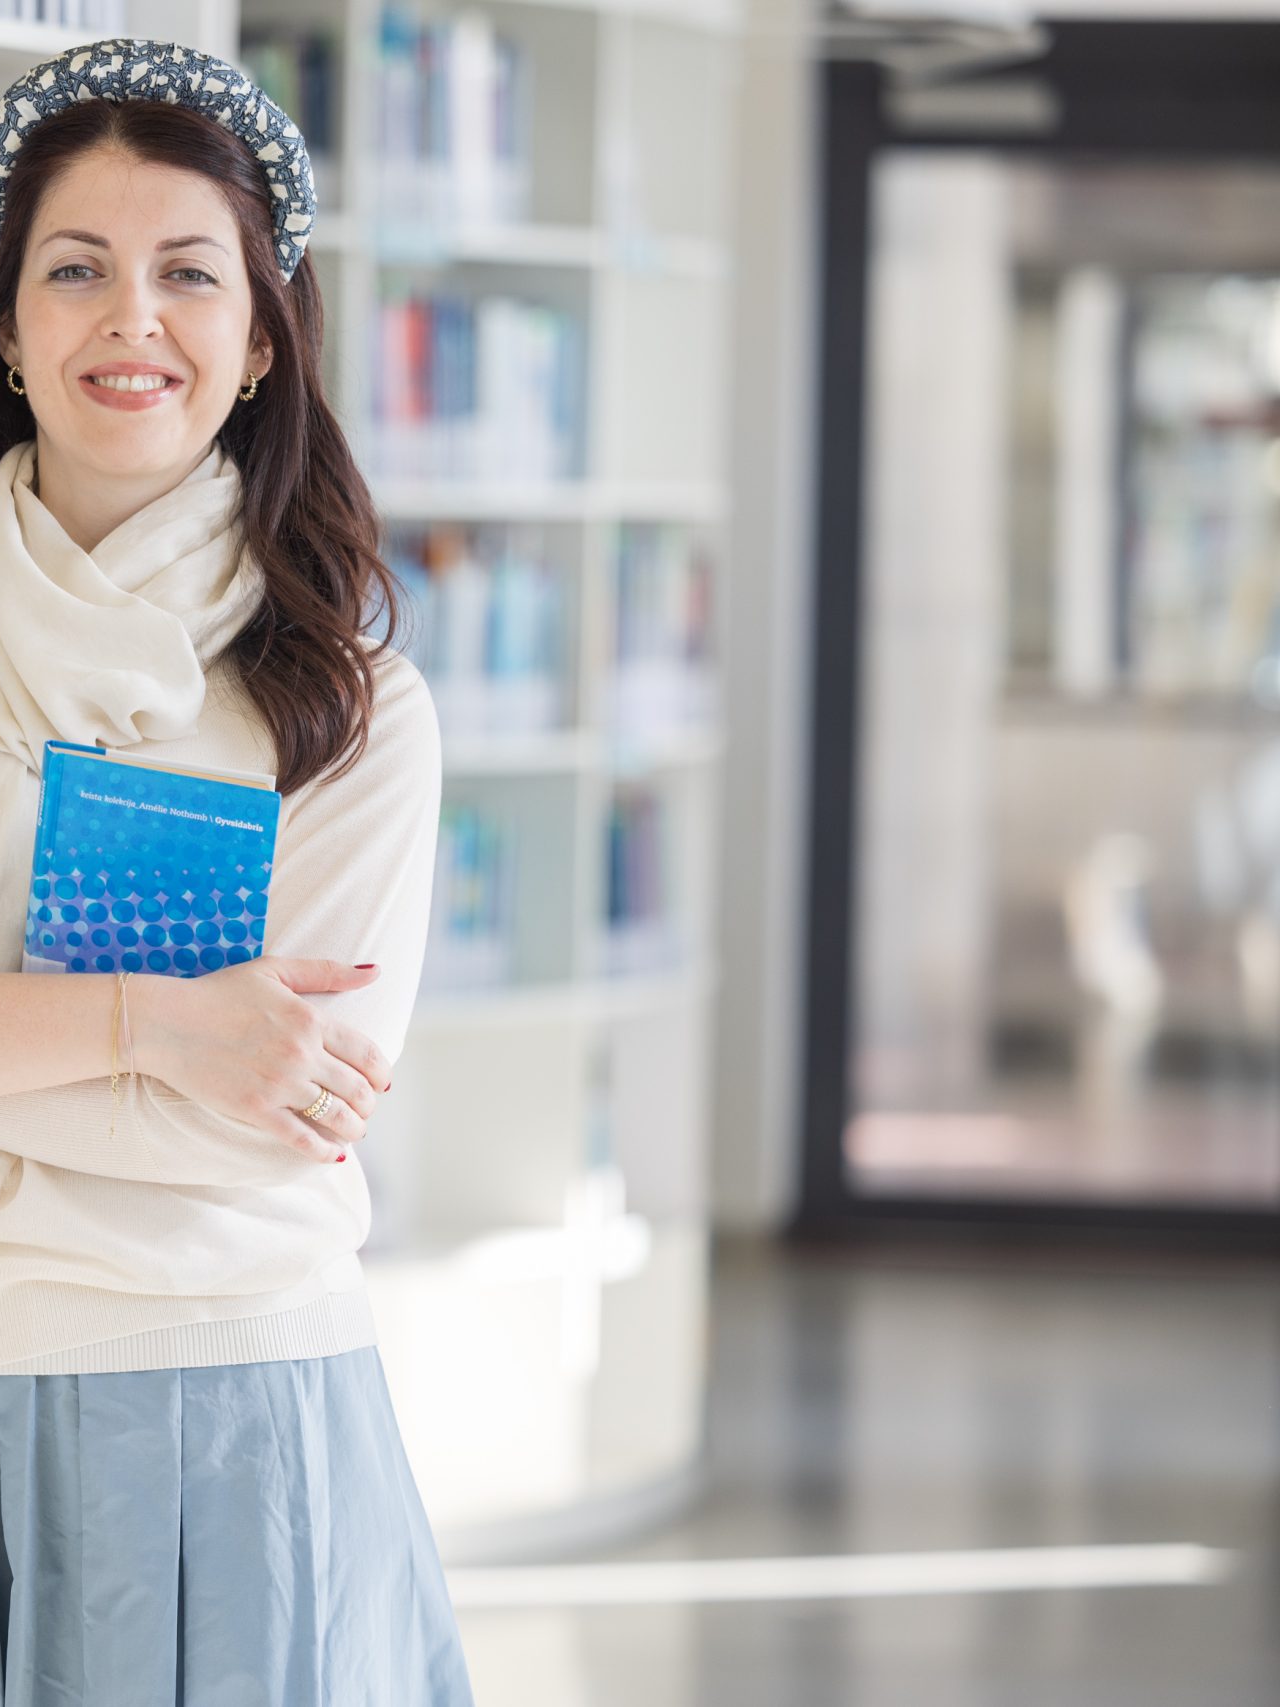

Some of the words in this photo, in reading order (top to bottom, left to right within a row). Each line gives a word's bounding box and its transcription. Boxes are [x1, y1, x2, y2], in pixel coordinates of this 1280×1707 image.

[80, 790, 102, 802] keista
[170, 807, 208, 821] Nothomb
[215, 816, 264, 832] Gyvsidabris
